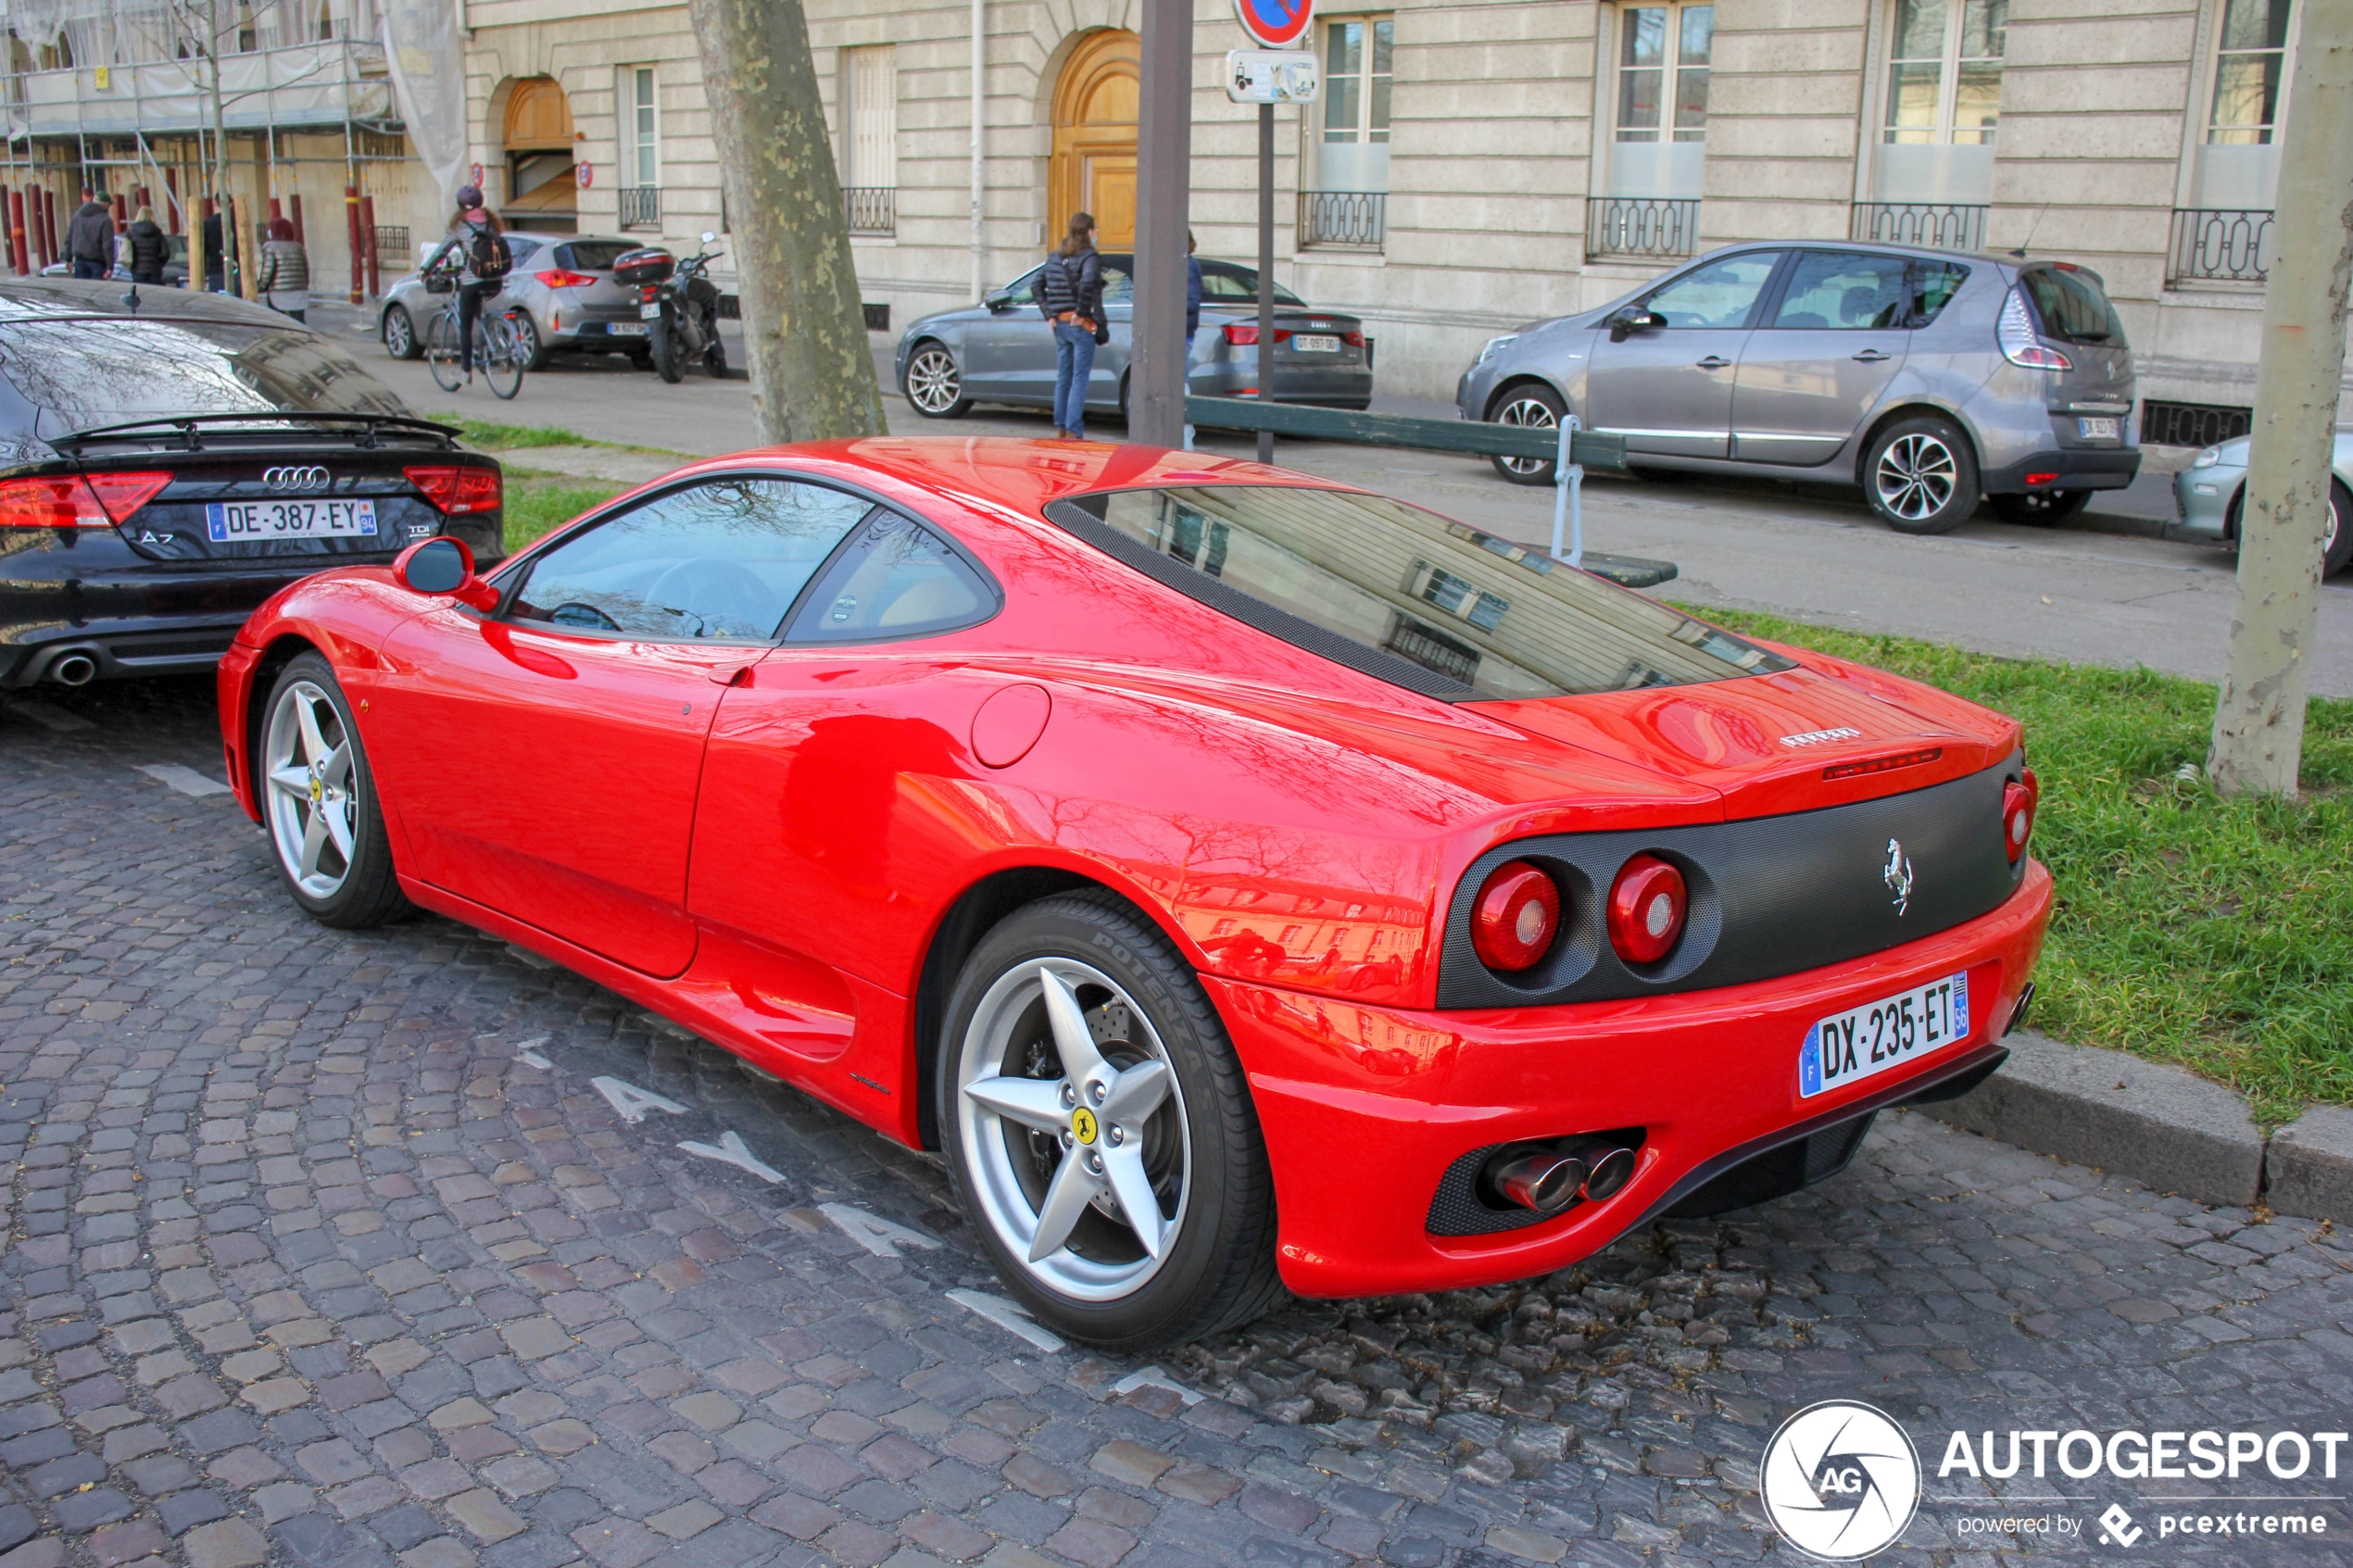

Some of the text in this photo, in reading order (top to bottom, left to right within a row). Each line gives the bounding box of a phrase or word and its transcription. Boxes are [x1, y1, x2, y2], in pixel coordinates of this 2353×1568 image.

[227, 503, 356, 533] DE-387-EY
[360, 518, 373, 530] 94
[141, 530, 174, 545] A7
[215, 524, 221, 533] F
[408, 525, 430, 533] TDI
[1091, 931, 1205, 1074] POTENZA
[1955, 1006, 1967, 1030] 56
[1822, 983, 1950, 1080] DX-235-ET
[1807, 1064, 1815, 1082] F
